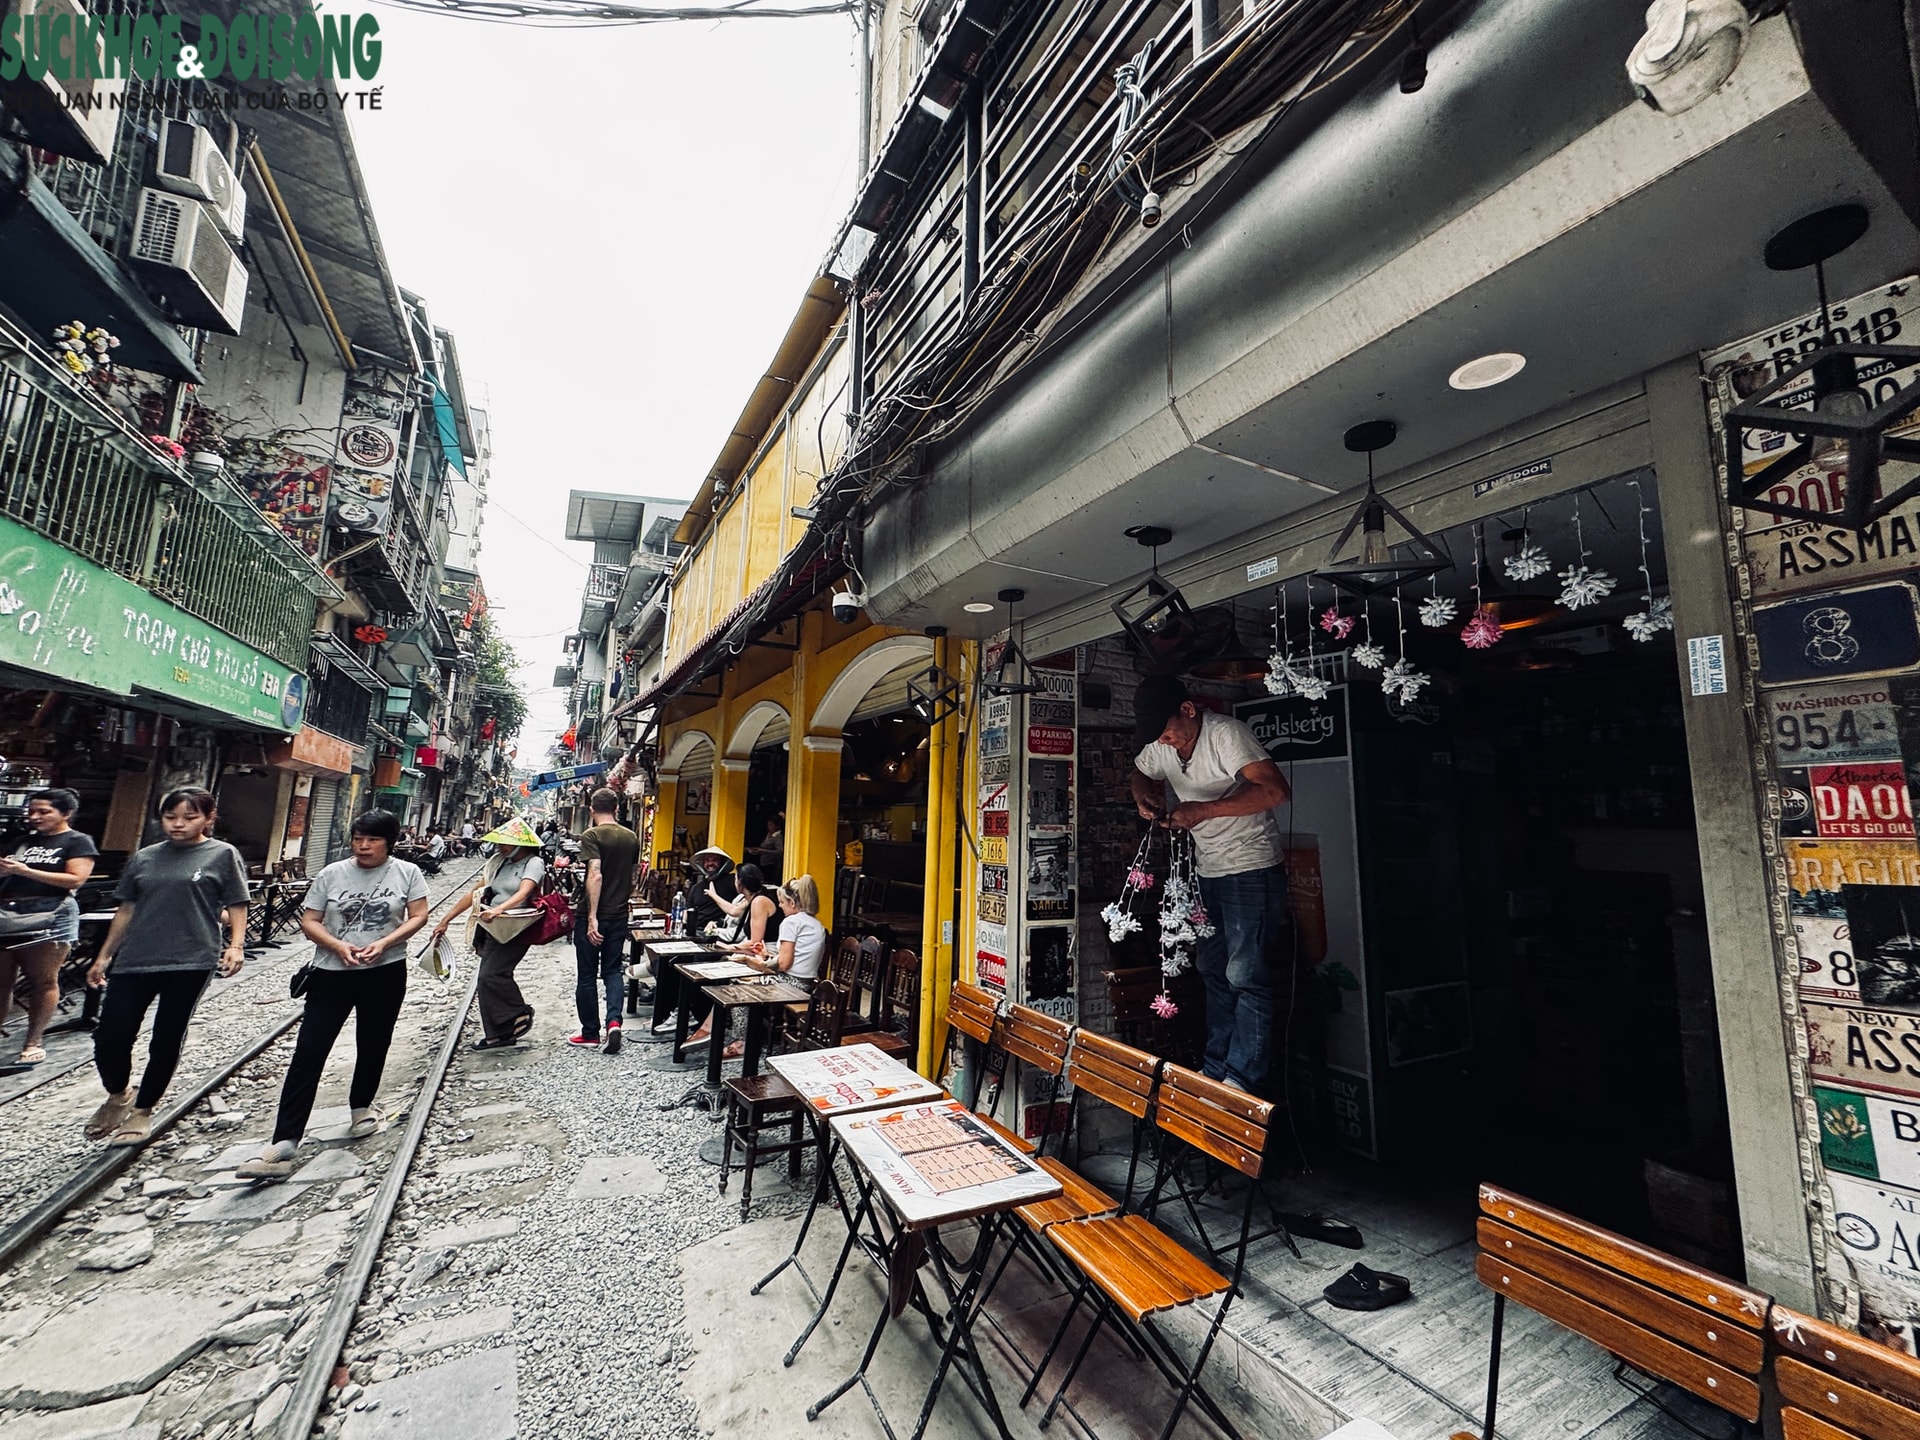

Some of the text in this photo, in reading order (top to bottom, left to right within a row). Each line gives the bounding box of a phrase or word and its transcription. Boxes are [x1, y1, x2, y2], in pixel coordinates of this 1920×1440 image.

[1763, 305, 1849, 349] TEXAS
[1780, 522, 1823, 540] NEW
[1779, 505, 1920, 580] ASSMA
[1803, 606, 1860, 668] 8
[1707, 636, 1724, 694] 0971.662.841
[1777, 691, 1890, 712] WASHINGTO
[1030, 728, 1073, 741] NO PARKING
[1824, 766, 1905, 786] Alberta
[1815, 784, 1913, 822] DAO
[1821, 823, 1860, 835] LET'S
[1864, 823, 1884, 835] GO
[1847, 1010, 1899, 1028] NEW
[1034, 1075, 1066, 1096] SOBR
